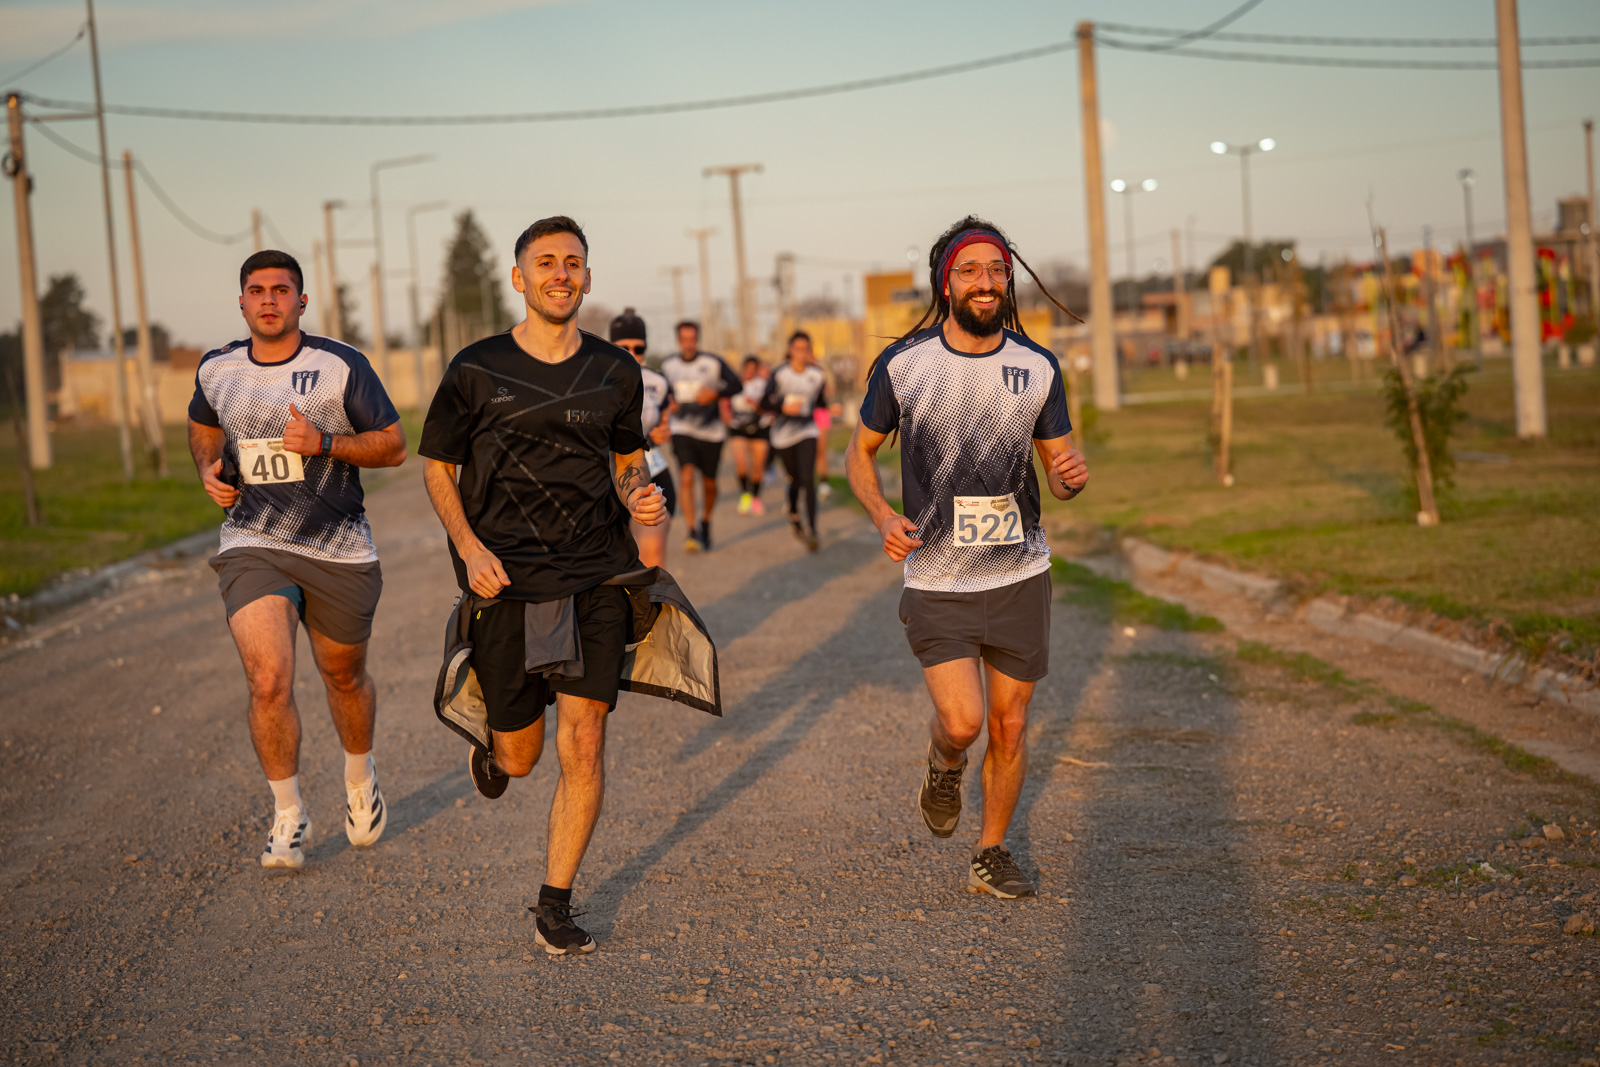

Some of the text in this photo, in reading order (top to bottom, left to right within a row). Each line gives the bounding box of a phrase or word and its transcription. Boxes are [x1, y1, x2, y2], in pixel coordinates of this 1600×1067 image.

[1007, 368, 1025, 377] SFC
[252, 453, 290, 481] 40
[958, 511, 1021, 544] 522
